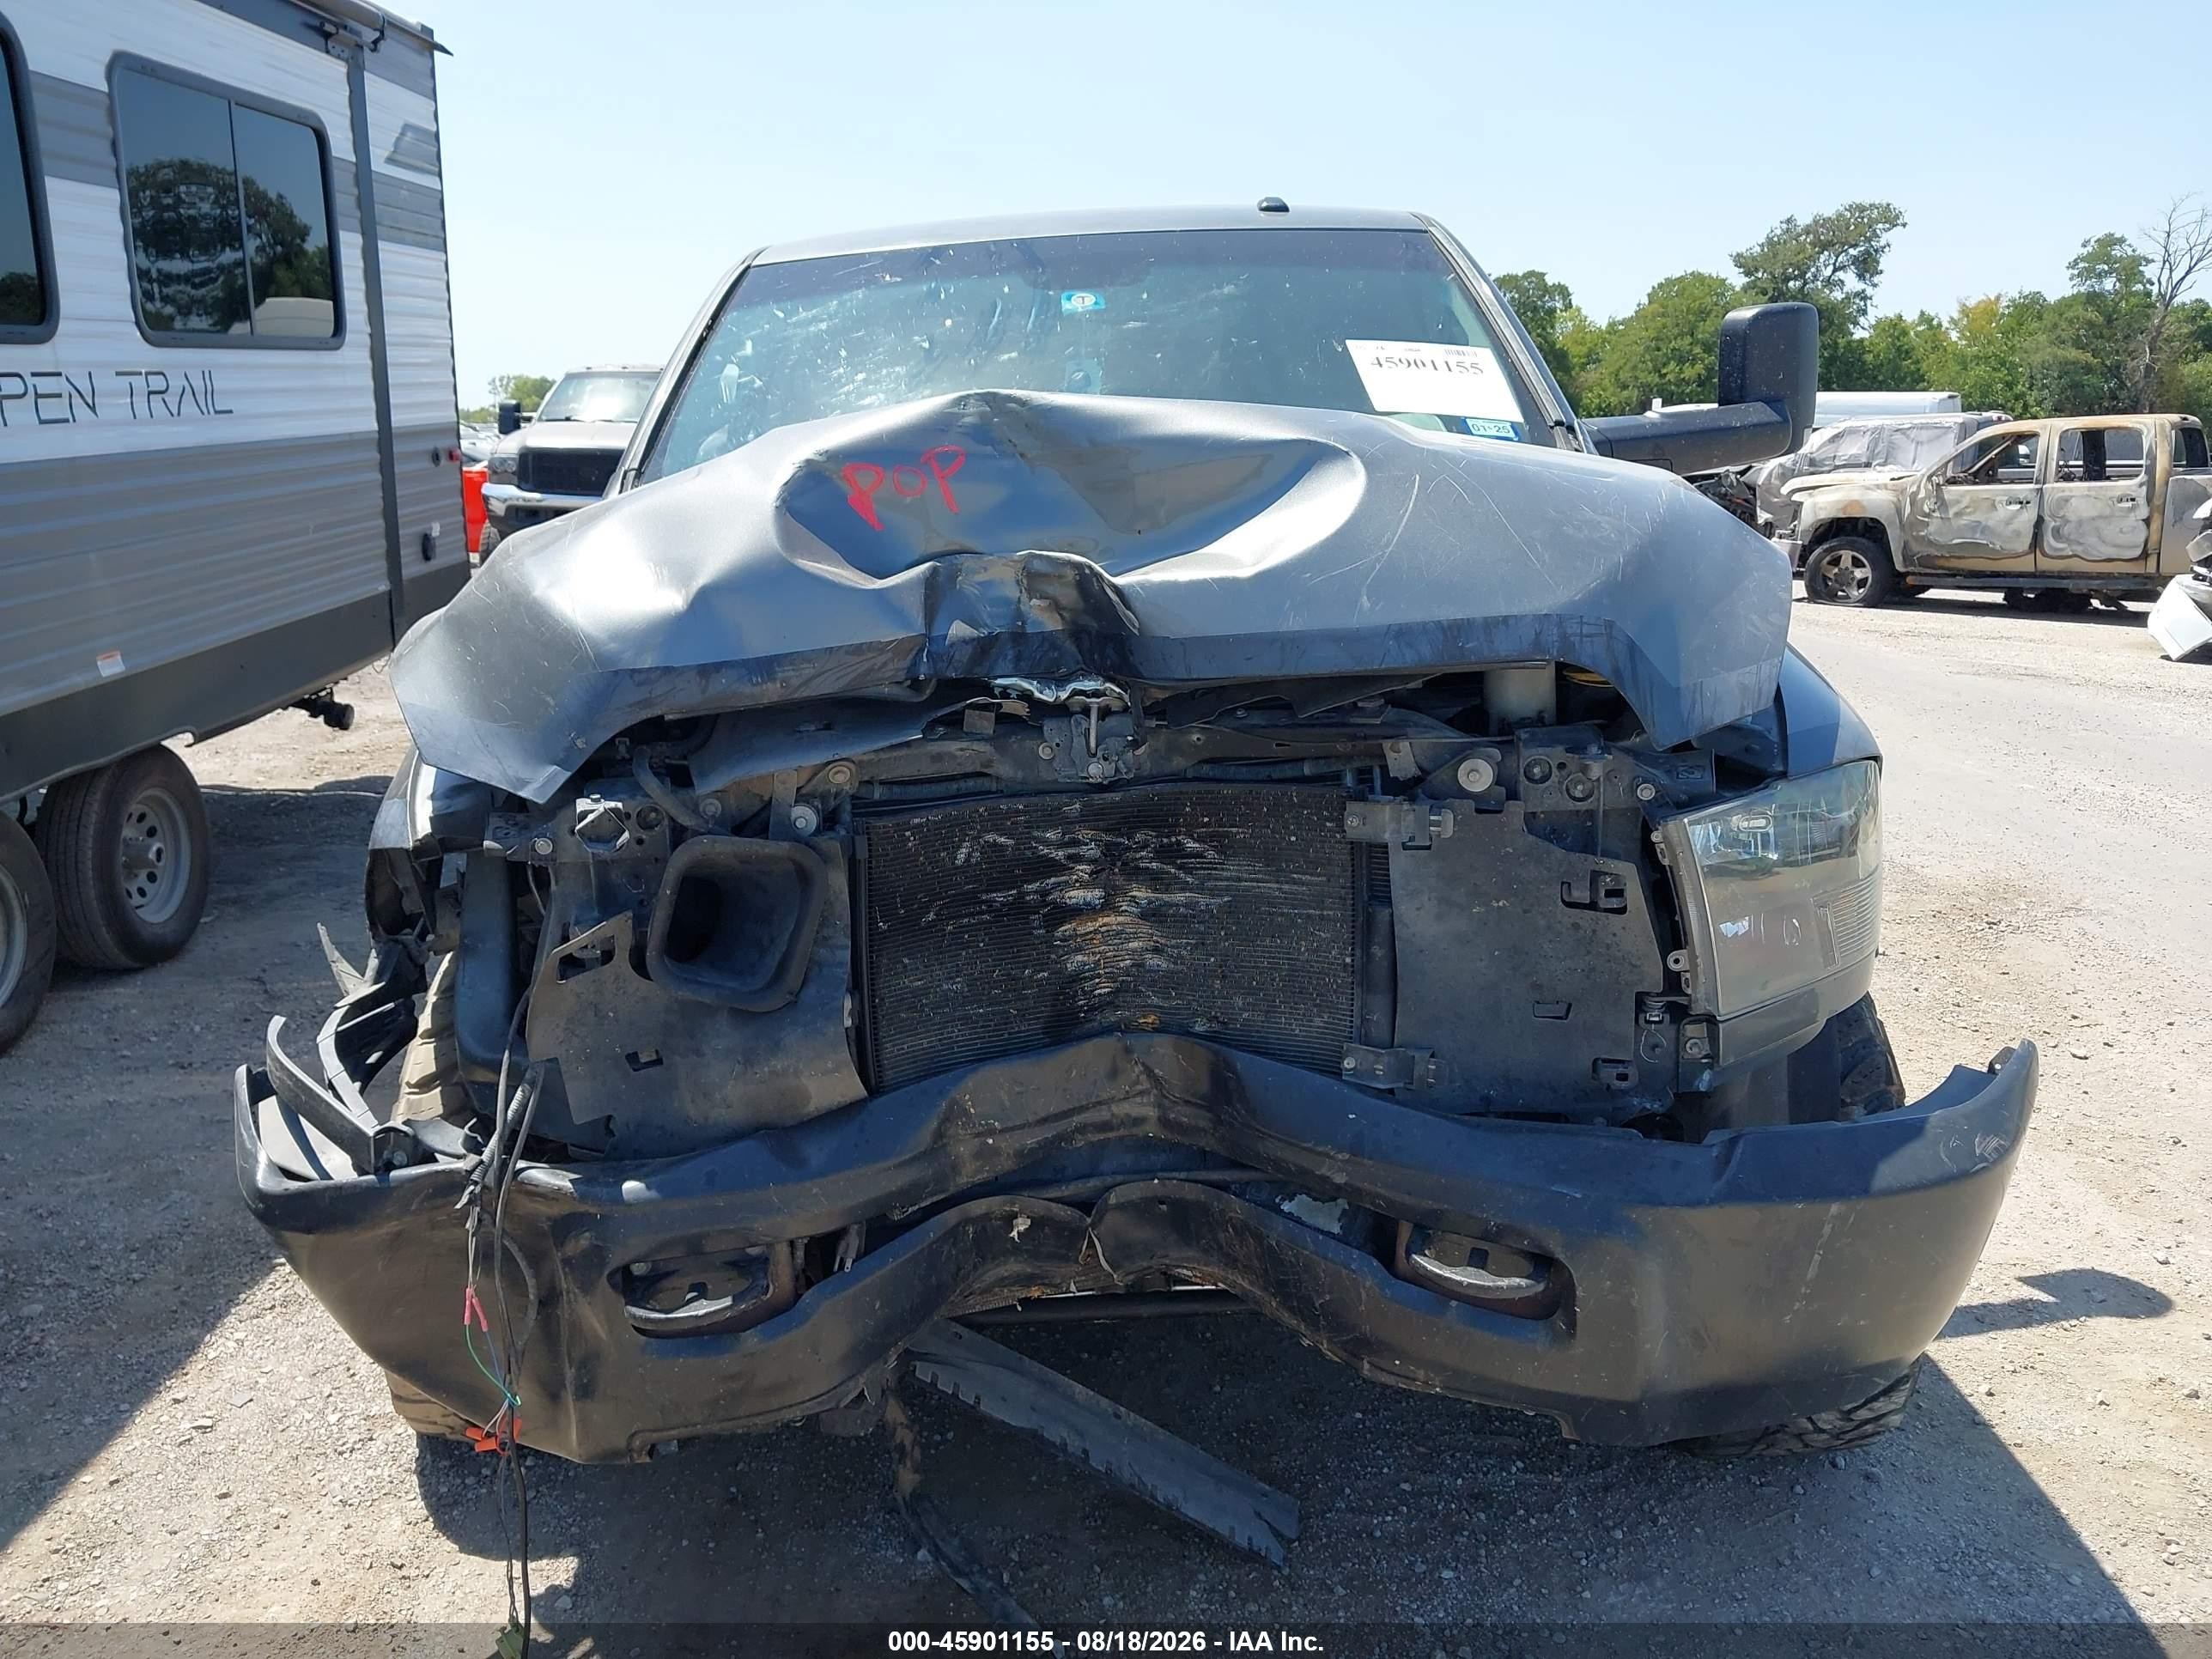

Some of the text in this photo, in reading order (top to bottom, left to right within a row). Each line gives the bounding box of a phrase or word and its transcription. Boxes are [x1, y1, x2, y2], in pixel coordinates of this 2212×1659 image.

[1370, 356, 1484, 375] 45901155
[115, 370, 234, 420] TRAIL
[1493, 425, 1510, 434] 25
[841, 445, 967, 532] POP
